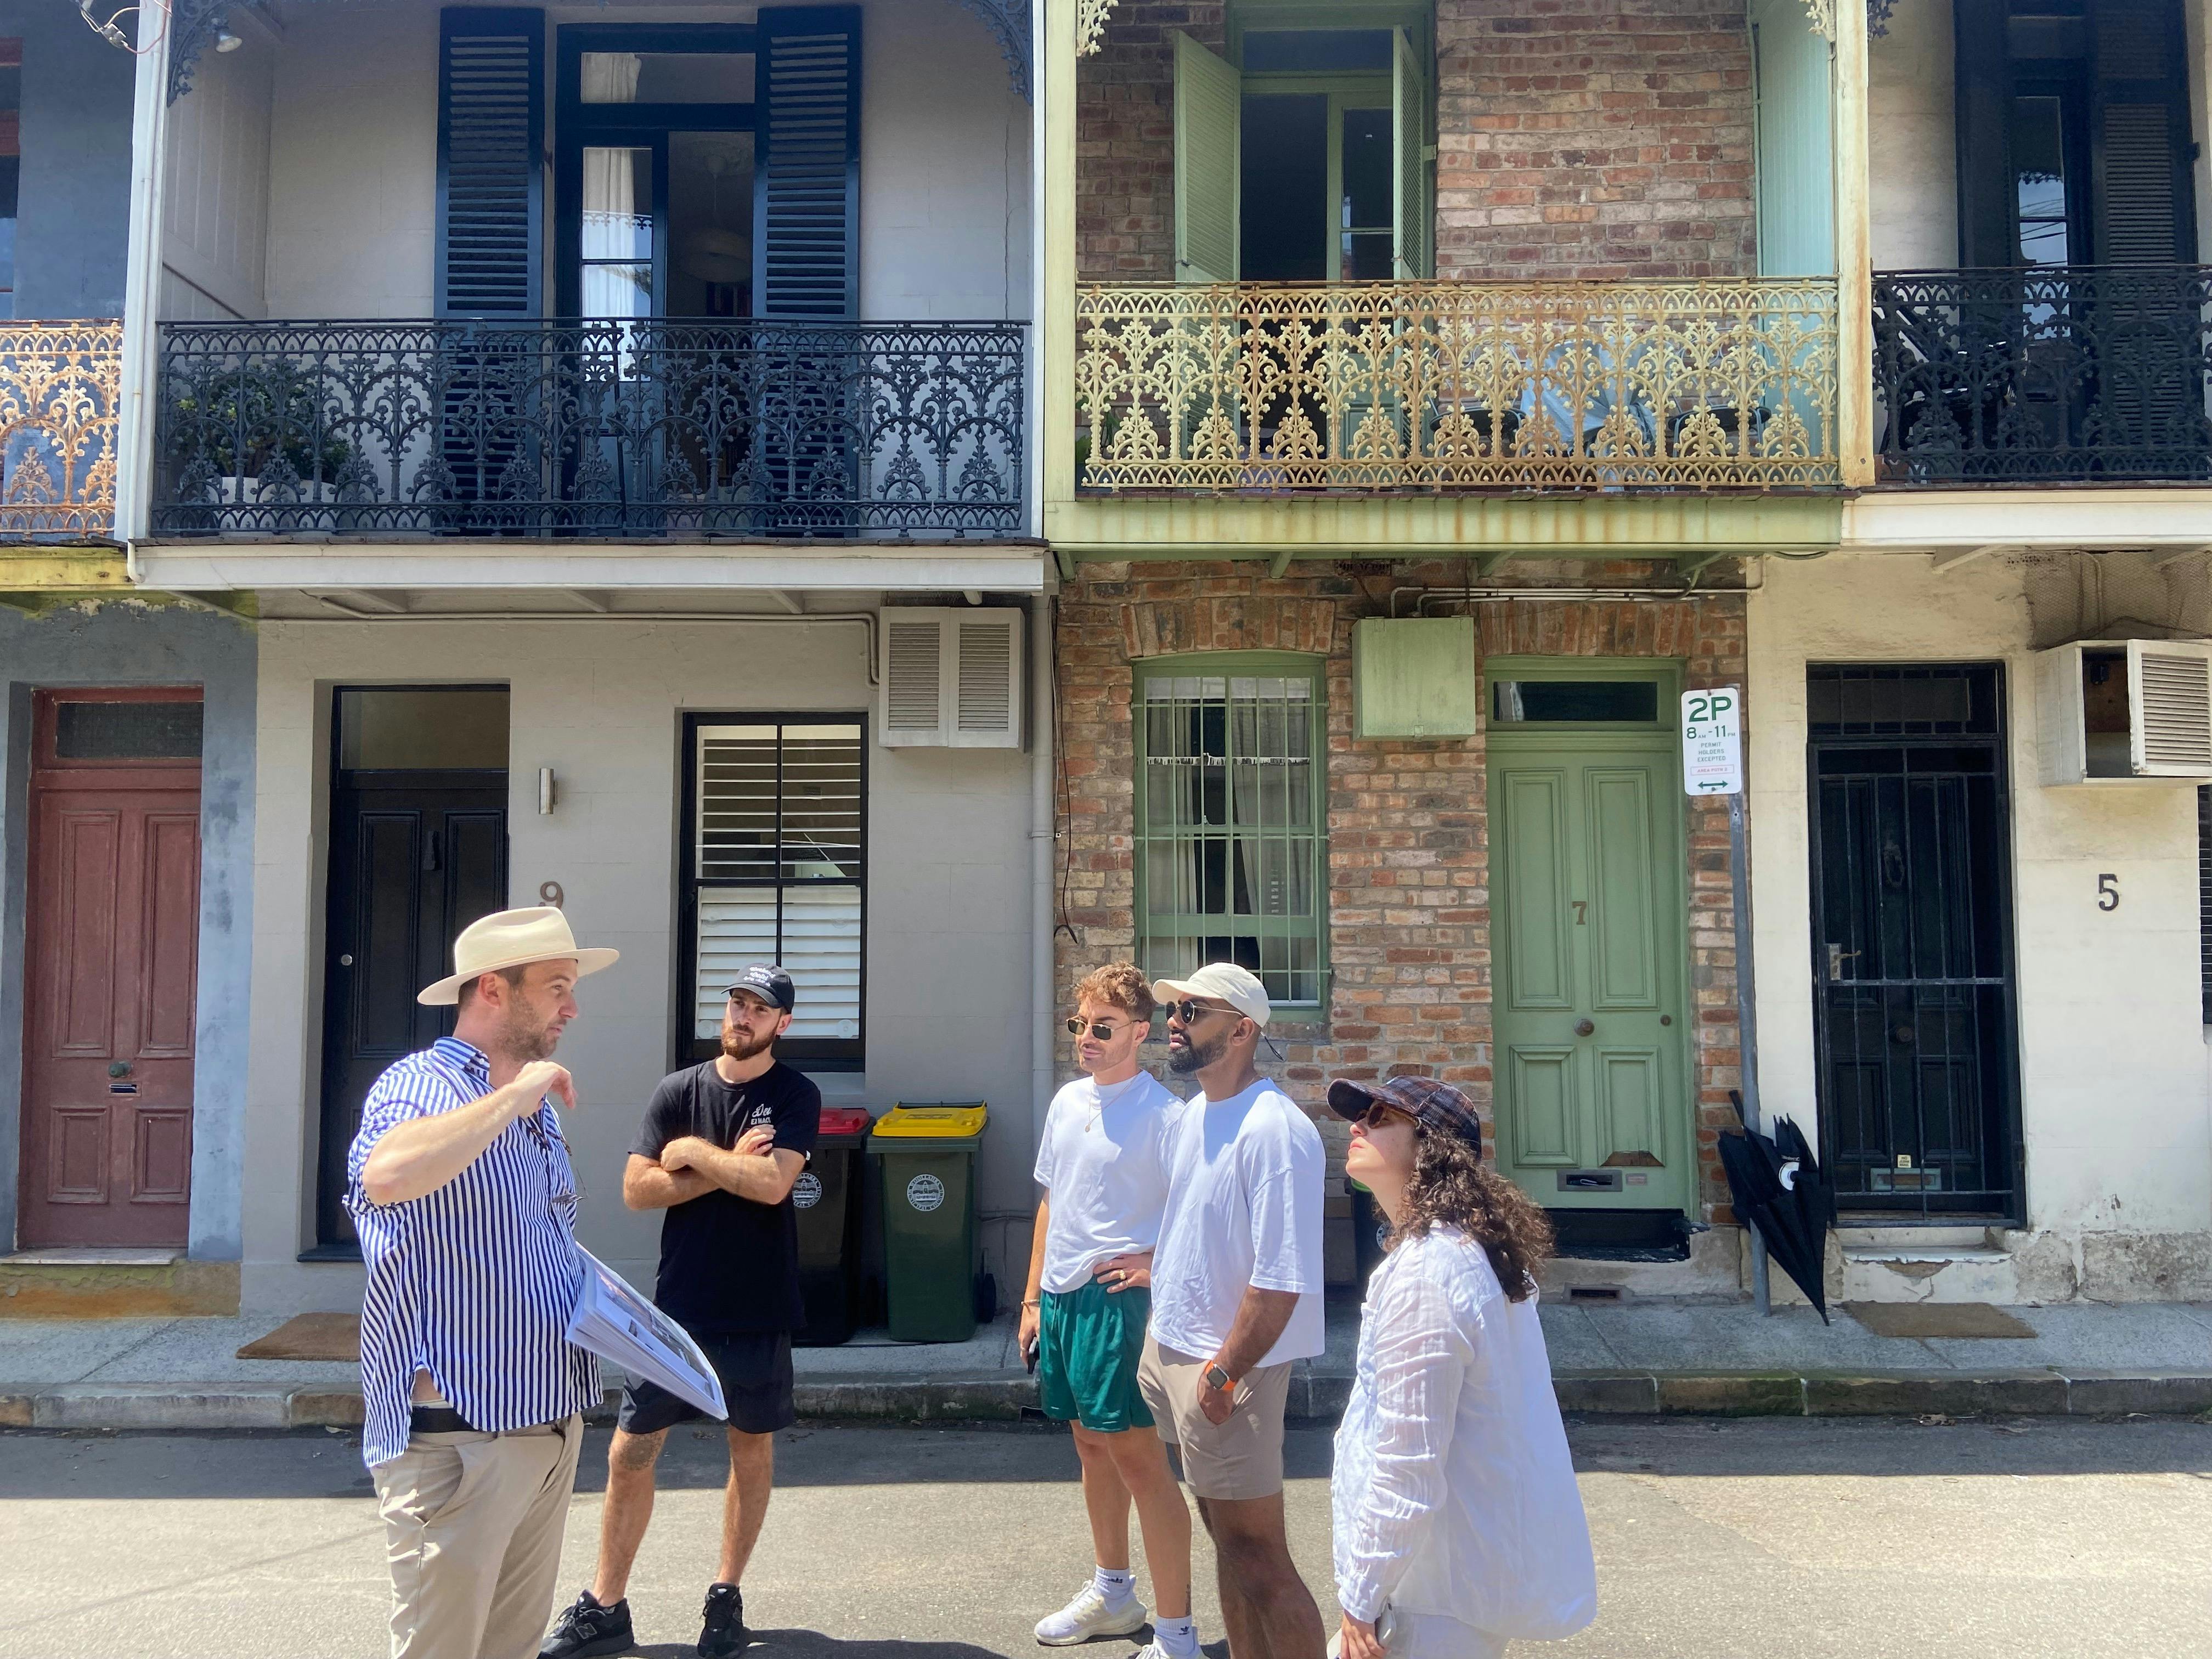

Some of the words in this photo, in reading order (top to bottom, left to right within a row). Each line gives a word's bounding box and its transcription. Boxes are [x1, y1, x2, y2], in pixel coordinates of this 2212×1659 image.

[1688, 696, 1732, 722] 2P
[539, 881, 563, 909] 9
[2098, 873, 2119, 911] 5
[1572, 901, 1587, 925] 7
